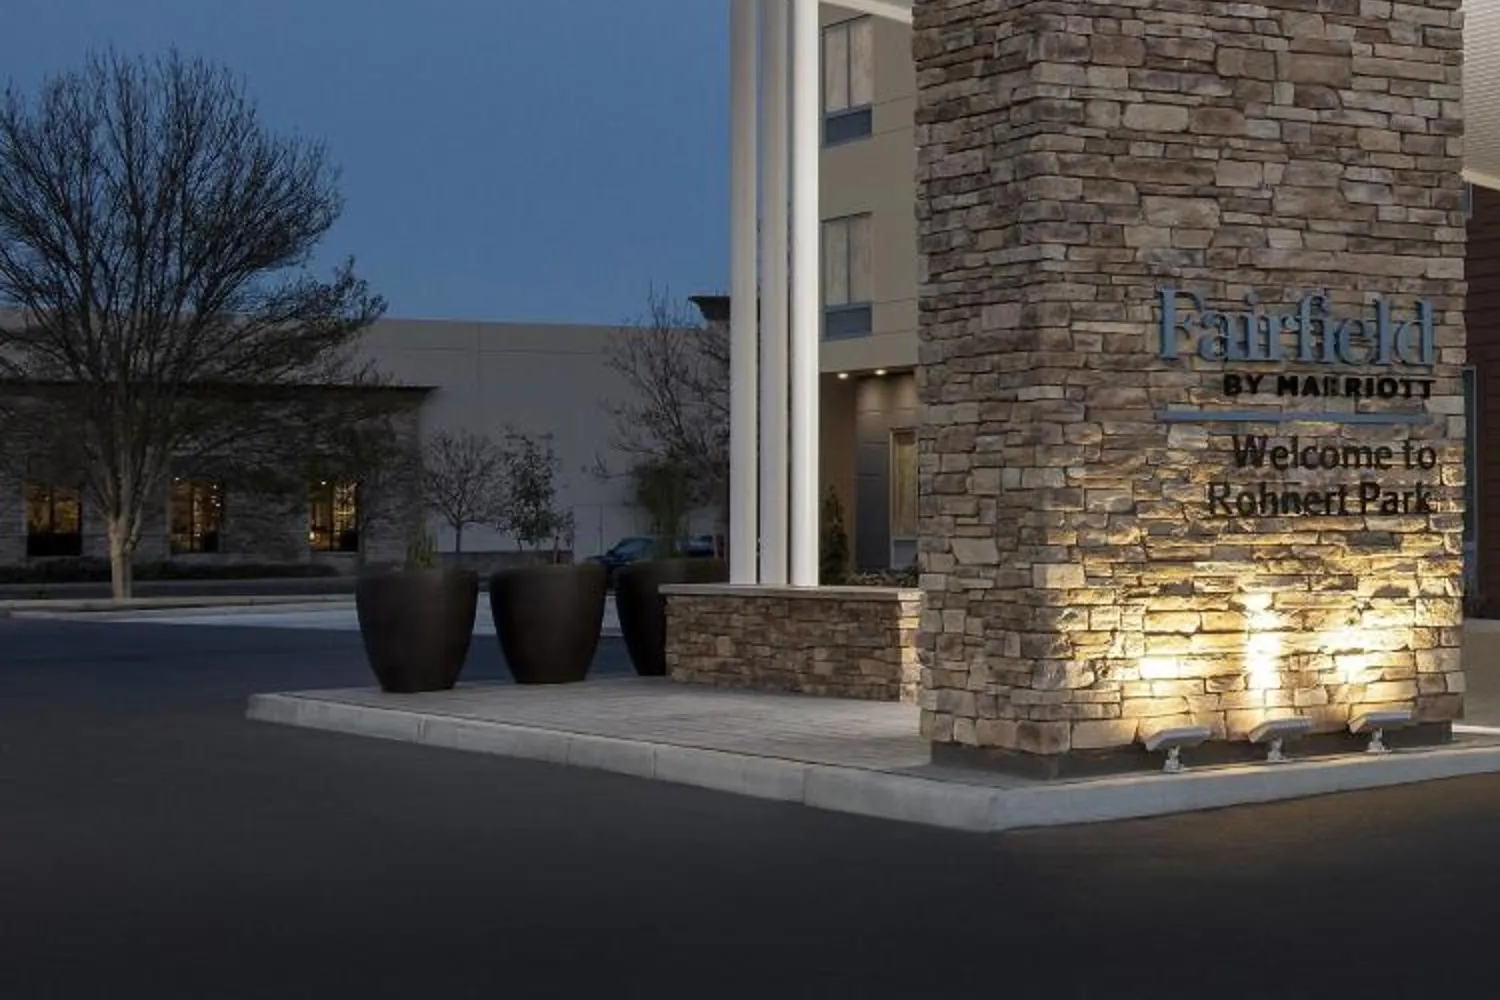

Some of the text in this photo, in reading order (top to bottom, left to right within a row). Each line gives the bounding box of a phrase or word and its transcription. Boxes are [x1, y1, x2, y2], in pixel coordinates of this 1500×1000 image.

[1157, 286, 1435, 367] Fairfield
[1222, 374, 1436, 399] BY MARRIOTT
[1231, 434, 1437, 470] Welcome to
[1206, 481, 1437, 516] Rohnert Park
